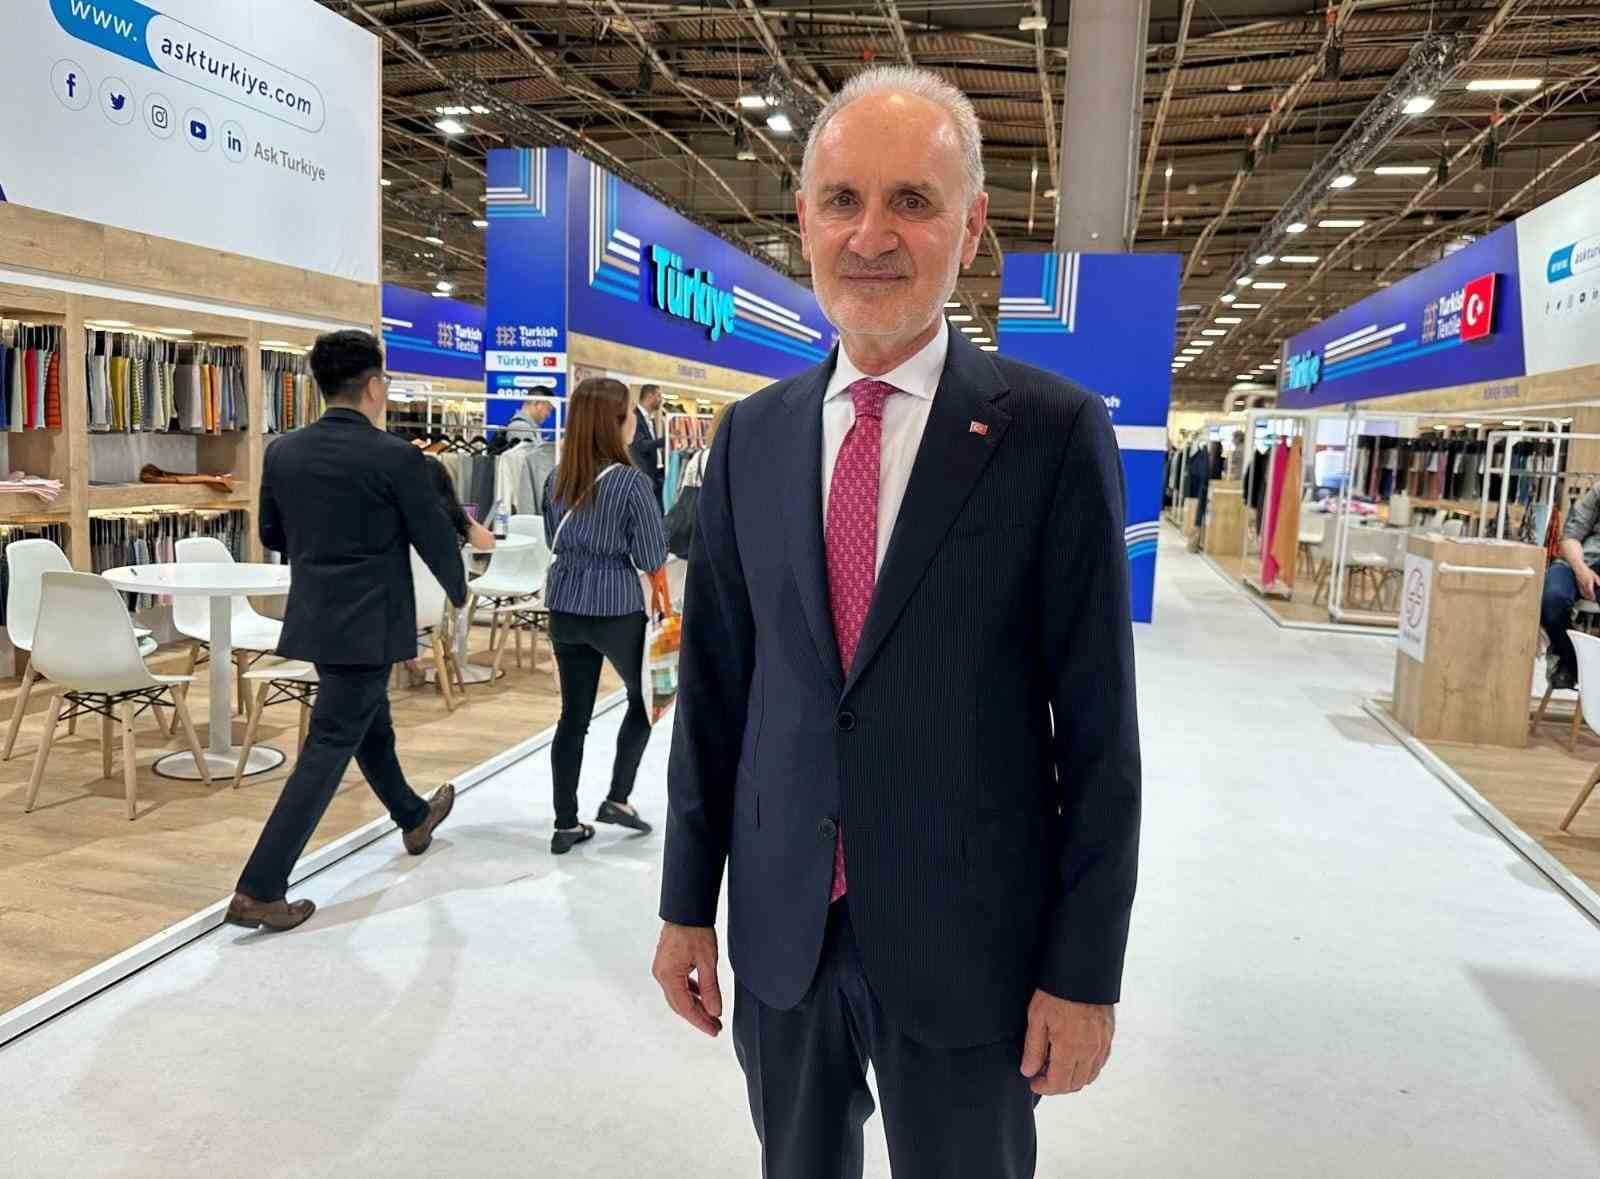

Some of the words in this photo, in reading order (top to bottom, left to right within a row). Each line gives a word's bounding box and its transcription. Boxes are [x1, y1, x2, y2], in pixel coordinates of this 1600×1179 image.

[160, 36, 312, 116] askturkiye.com
[652, 244, 736, 341] Türkiye
[518, 325, 558, 338] Turkish
[520, 337, 553, 348] Textile
[496, 354, 538, 369] Türkiye
